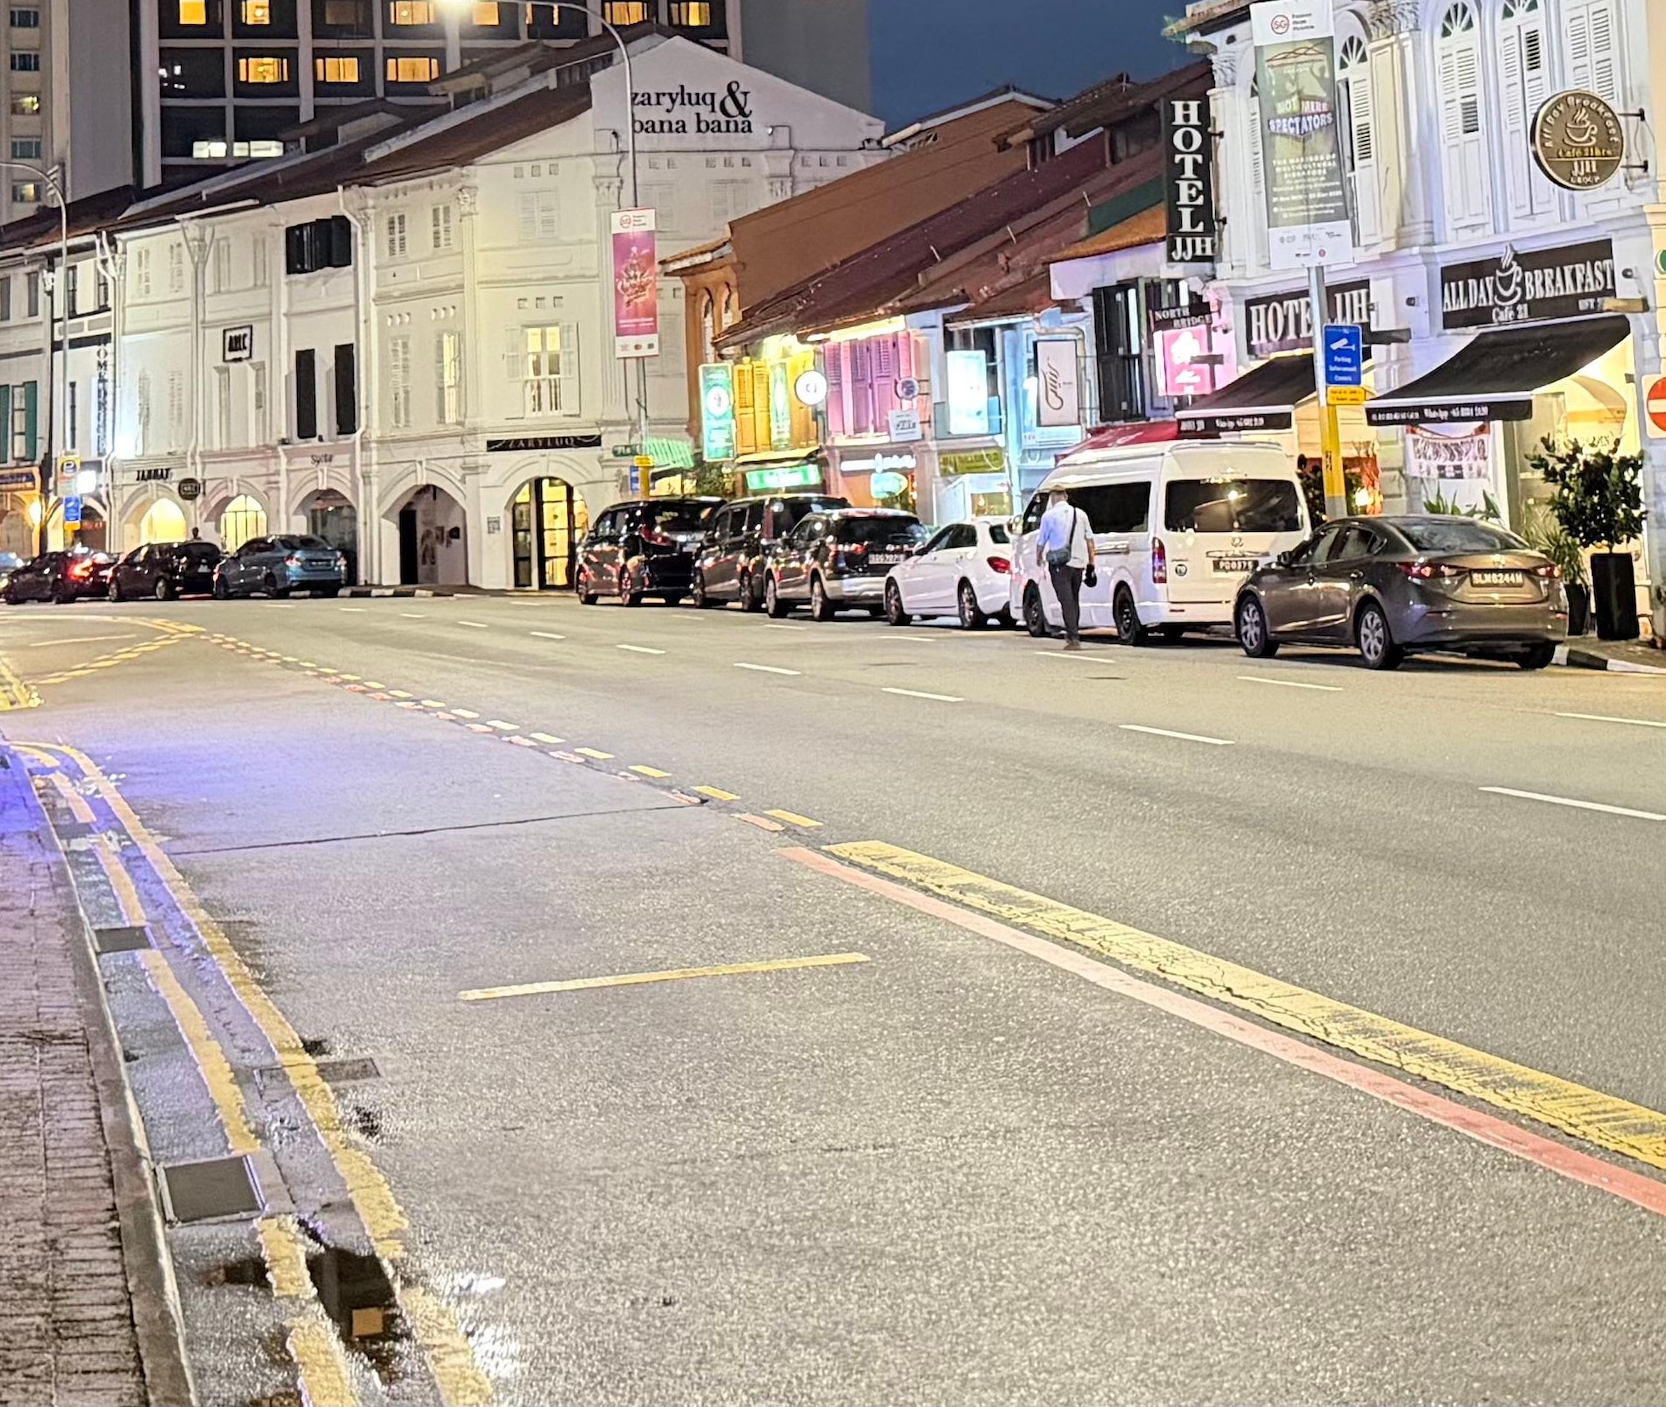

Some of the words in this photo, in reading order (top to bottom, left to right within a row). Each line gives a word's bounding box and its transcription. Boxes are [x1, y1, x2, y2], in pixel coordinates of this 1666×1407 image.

[632, 84, 716, 113] zaryluq
[720, 80, 753, 118] &
[633, 113, 687, 134] bana
[695, 112, 753, 134] bana
[1269, 113, 1334, 135] SPECTATORS
[1171, 100, 1205, 233] HOTEL
[1172, 236, 1215, 261] JJH
[1443, 280, 1468, 312] ALL
[1468, 276, 1495, 308] DAY
[1524, 259, 1615, 301] BREAKFAST
[1155, 307, 1190, 322] NORTH
[1173, 314, 1213, 329] BRIDGE
[1249, 297, 1313, 346] HOTE
